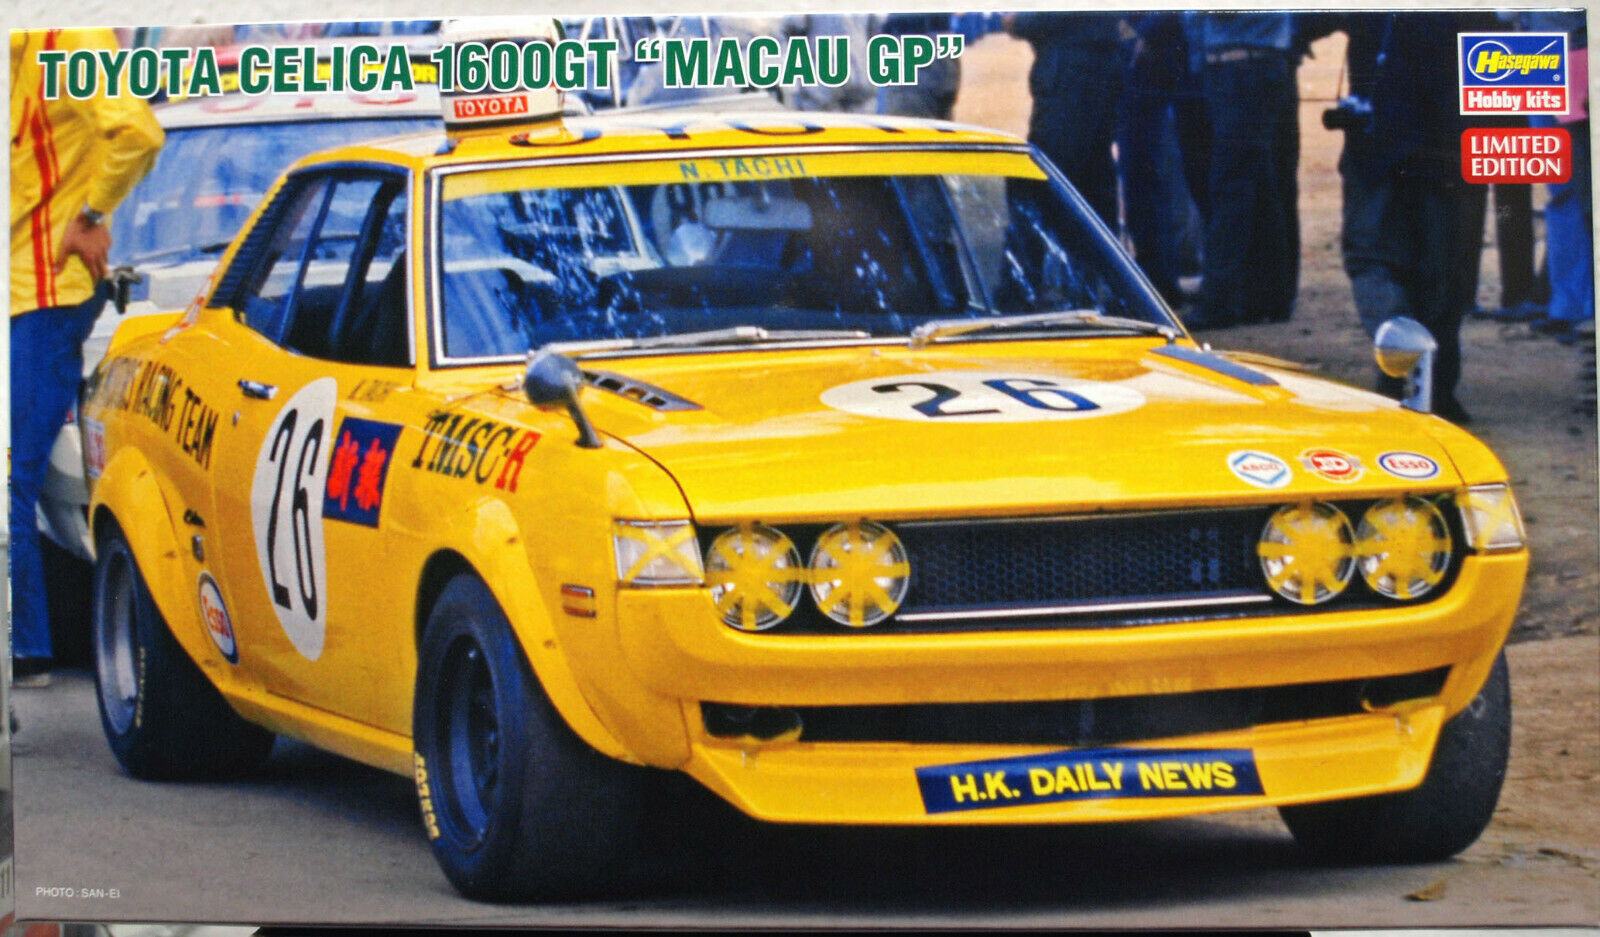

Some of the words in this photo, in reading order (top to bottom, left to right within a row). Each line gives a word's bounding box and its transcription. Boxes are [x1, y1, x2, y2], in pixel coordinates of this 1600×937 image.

[39, 47, 222, 98] TOYOTA
[240, 44, 415, 95] CELICA
[432, 40, 617, 91] 1600GT
[636, 37, 849, 88] “MACAU
[868, 34, 964, 85] GP”
[1475, 51, 1560, 75] Hasegawa
[457, 97, 525, 116] TOYOTA
[1467, 90, 1522, 111] Hobby
[1526, 90, 1561, 108] kits
[1470, 135, 1561, 155] LIMITED
[714, 156, 806, 177] TACHI
[1471, 157, 1561, 177] EDITION
[871, 378, 1102, 417] 26
[176, 387, 219, 471] TEAM
[266, 408, 324, 621] 26
[950, 771, 1021, 803] H.K.
[1029, 762, 1124, 797] DAILY
[1137, 761, 1237, 790] NEWS
